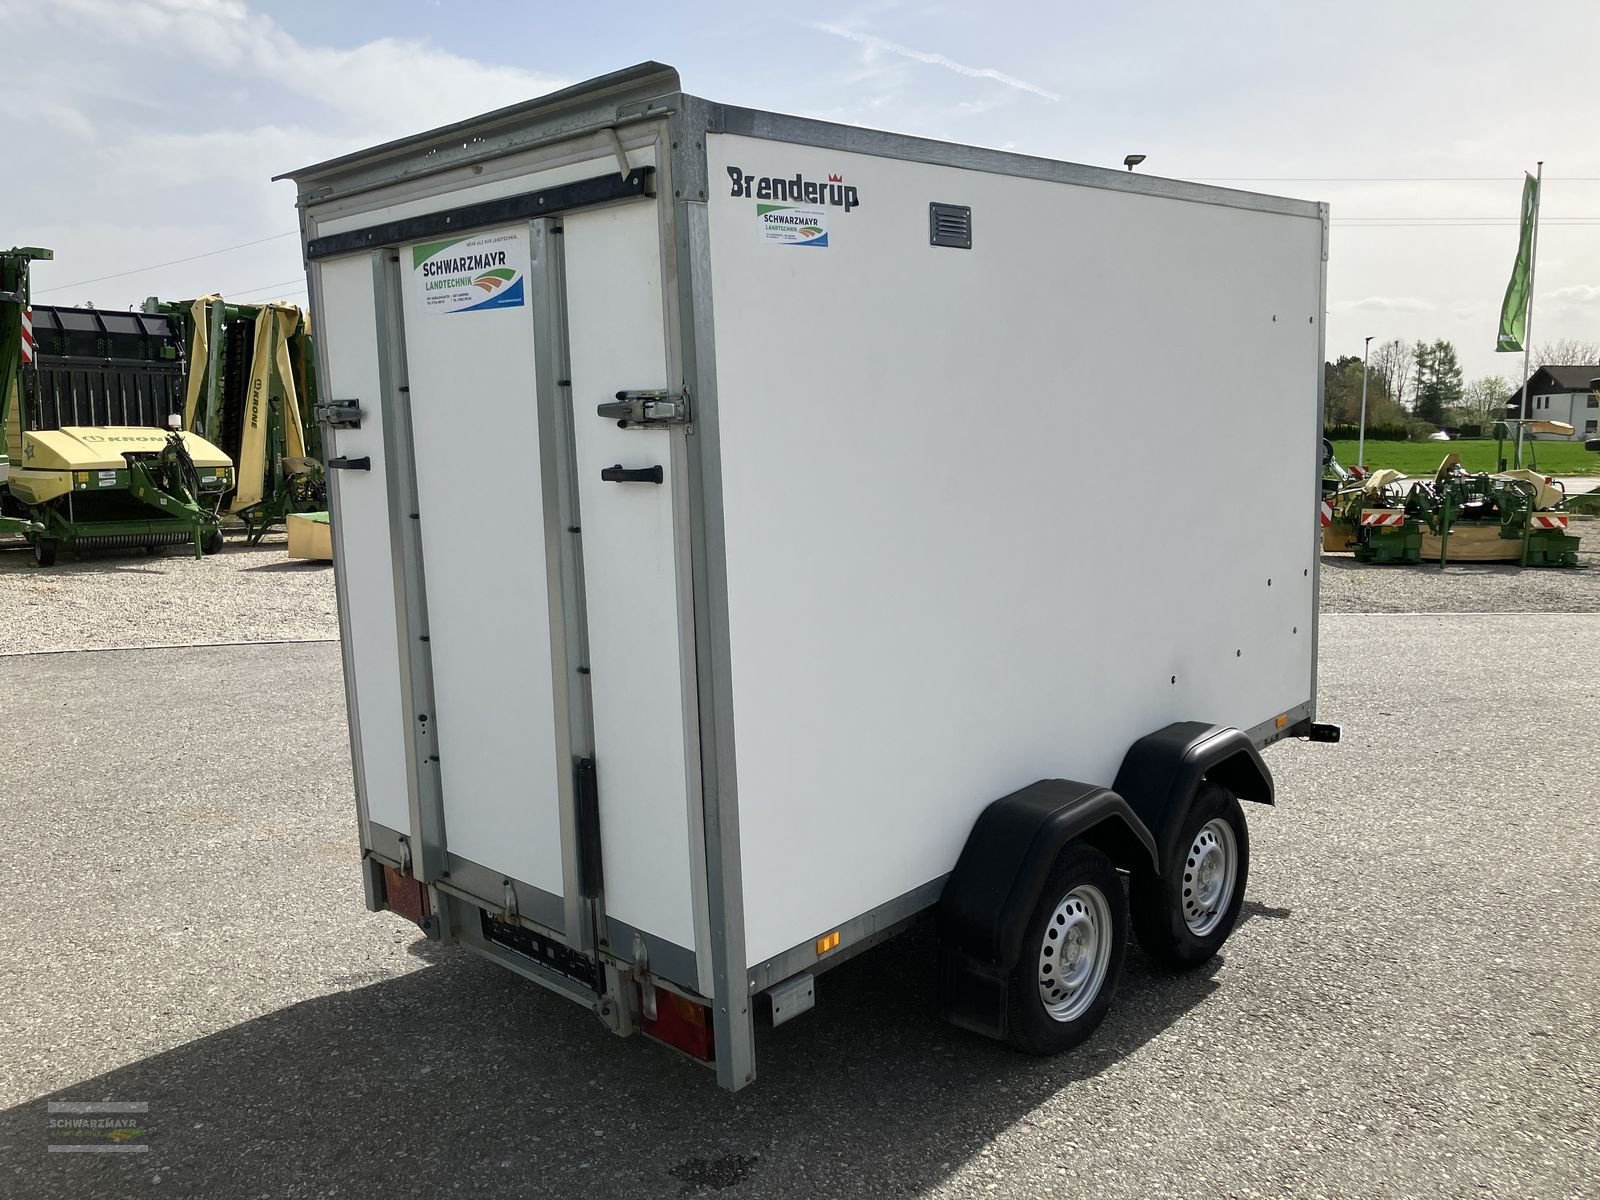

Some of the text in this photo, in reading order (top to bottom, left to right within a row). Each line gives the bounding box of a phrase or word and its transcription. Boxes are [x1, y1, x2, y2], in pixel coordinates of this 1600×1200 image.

[727, 166, 859, 212] Brenderup
[764, 214, 818, 226] SCHWARZMAYR
[423, 251, 506, 277] SCHWARZMAYR
[425, 276, 472, 291] LANDTECHNIK
[251, 391, 259, 429] KRONE
